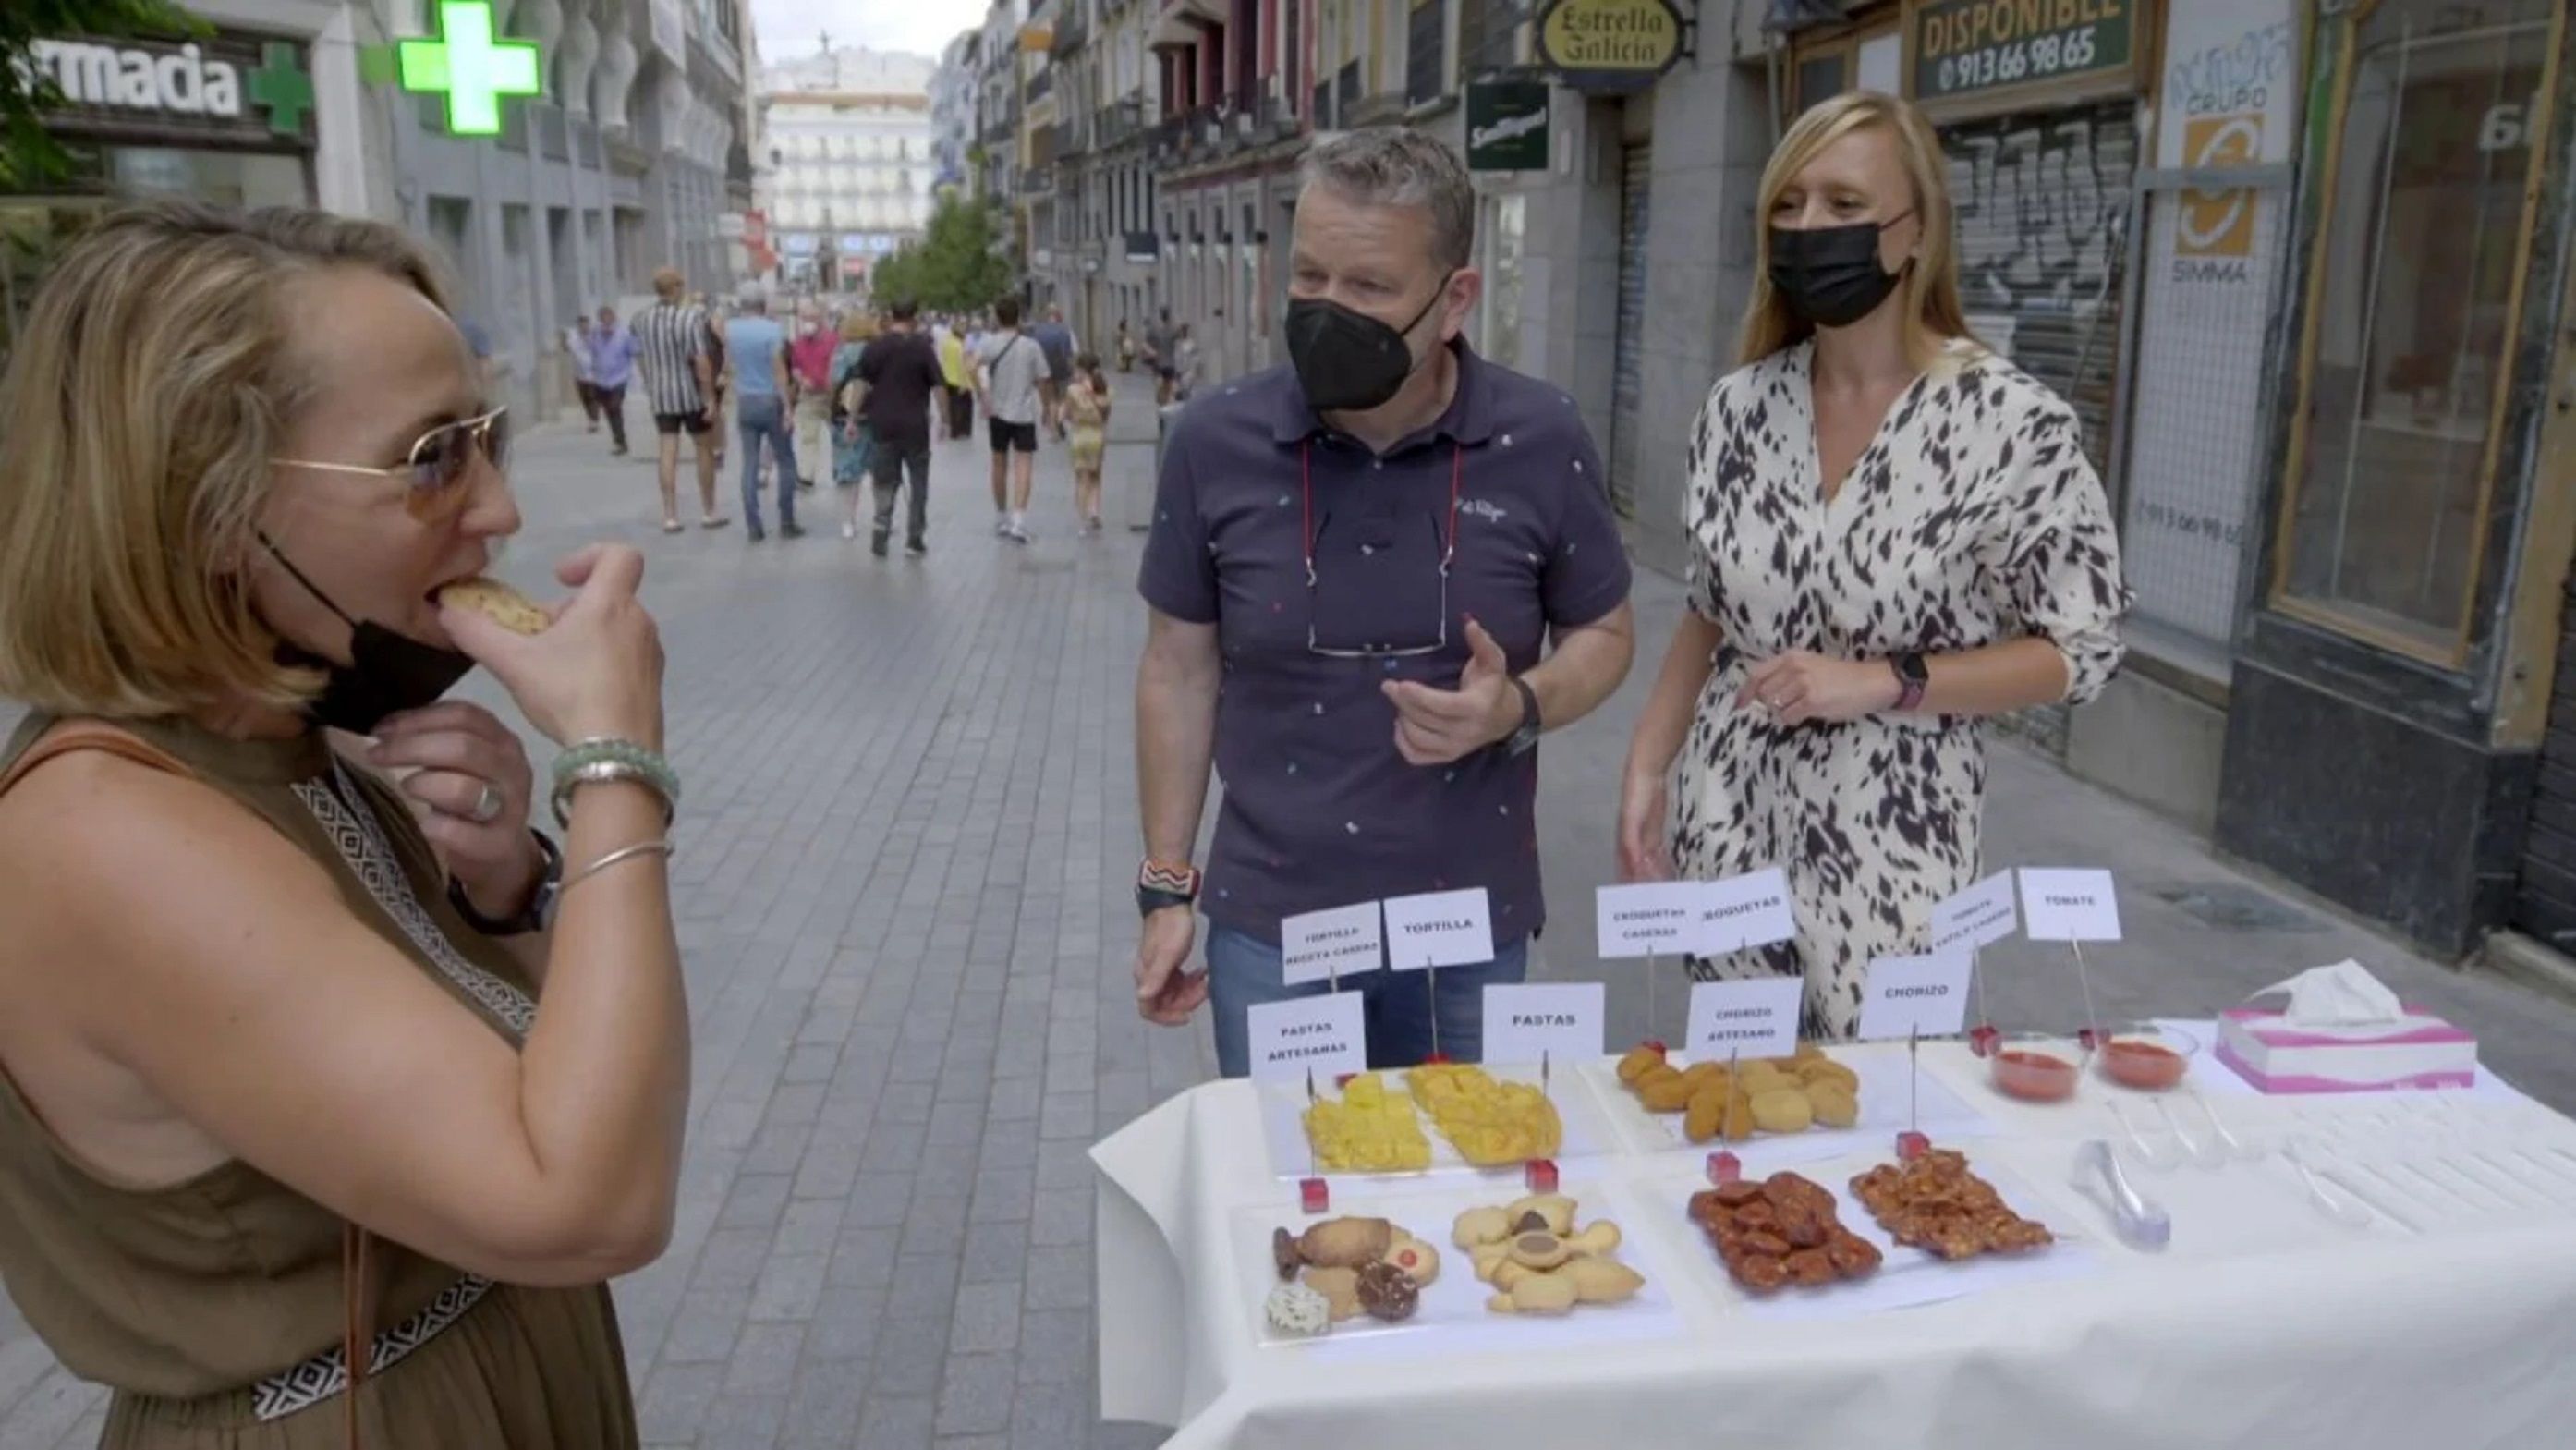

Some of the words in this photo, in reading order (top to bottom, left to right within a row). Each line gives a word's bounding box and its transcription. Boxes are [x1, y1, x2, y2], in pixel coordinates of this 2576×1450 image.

[1561, 5, 1663, 33] Estrella
[1565, 35, 1657, 62] Galicia
[2187, 88, 2267, 115] GRUPO
[2172, 260, 2247, 283] SIMMA
[1702, 896, 1780, 921] ROQUETAS
[2045, 895, 2096, 907] TOMATE
[1403, 919, 1473, 934] TORTILLA
[1885, 986, 1948, 999] CHORIZO
[1281, 1022, 1333, 1037] PASTAS
[1513, 1015, 1575, 1027] PASTAS
[1268, 1043, 1347, 1062] ARTESANAS
